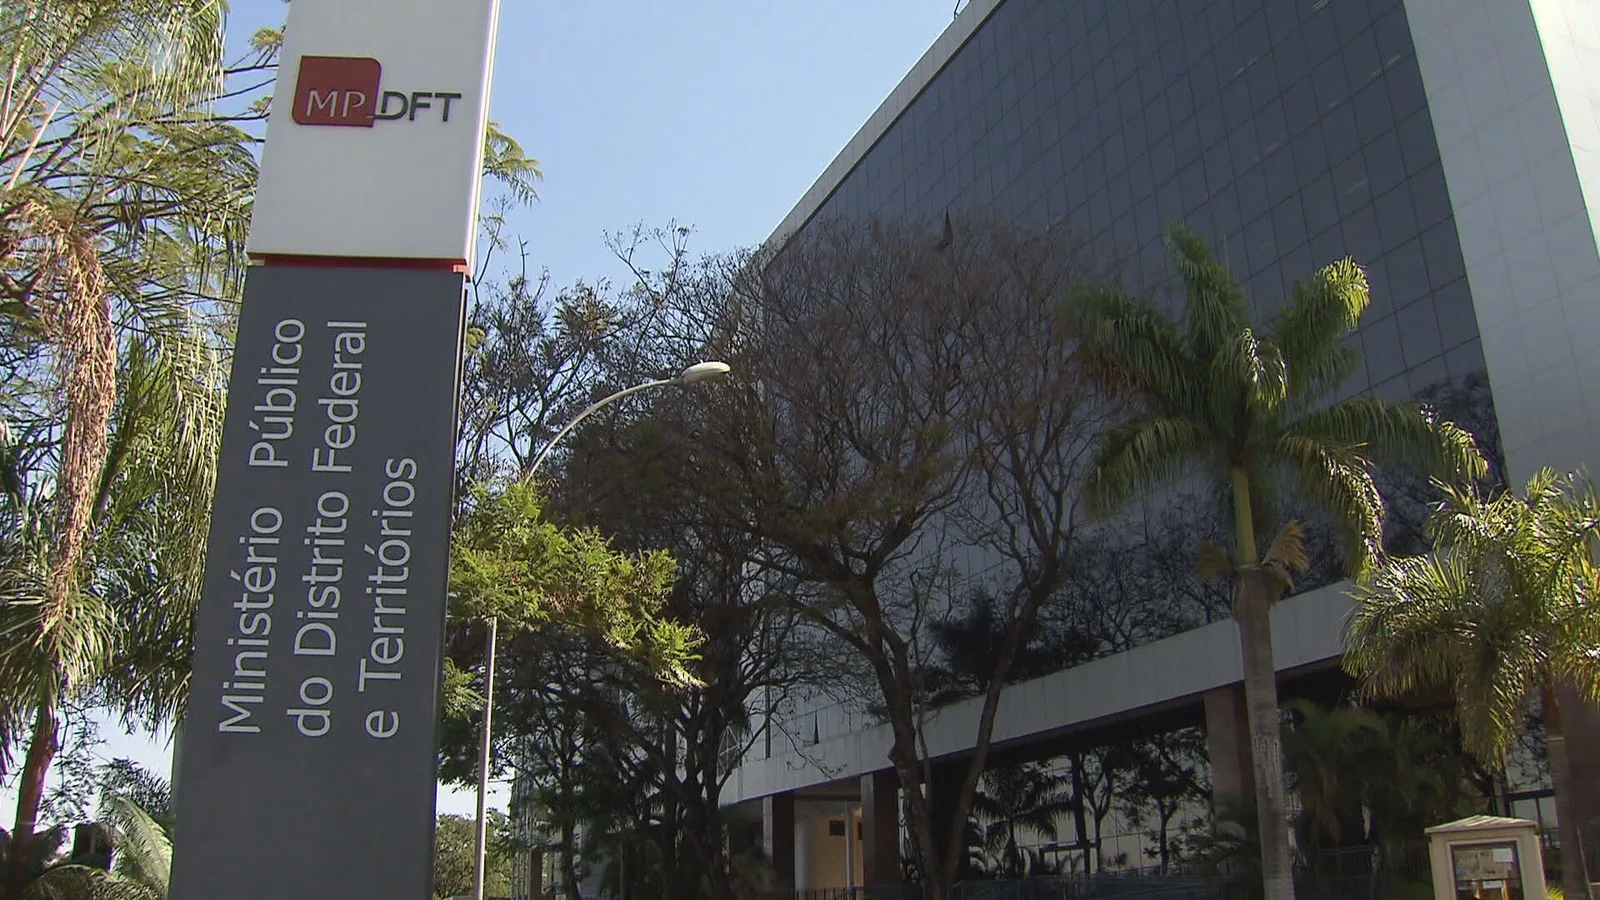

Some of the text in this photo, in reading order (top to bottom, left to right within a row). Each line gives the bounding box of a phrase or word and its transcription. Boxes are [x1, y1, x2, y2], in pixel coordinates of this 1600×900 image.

[218, 318, 306, 734] Ministério Público
[286, 321, 368, 738] do Distrito Federal
[357, 457, 418, 739] e Territórios
